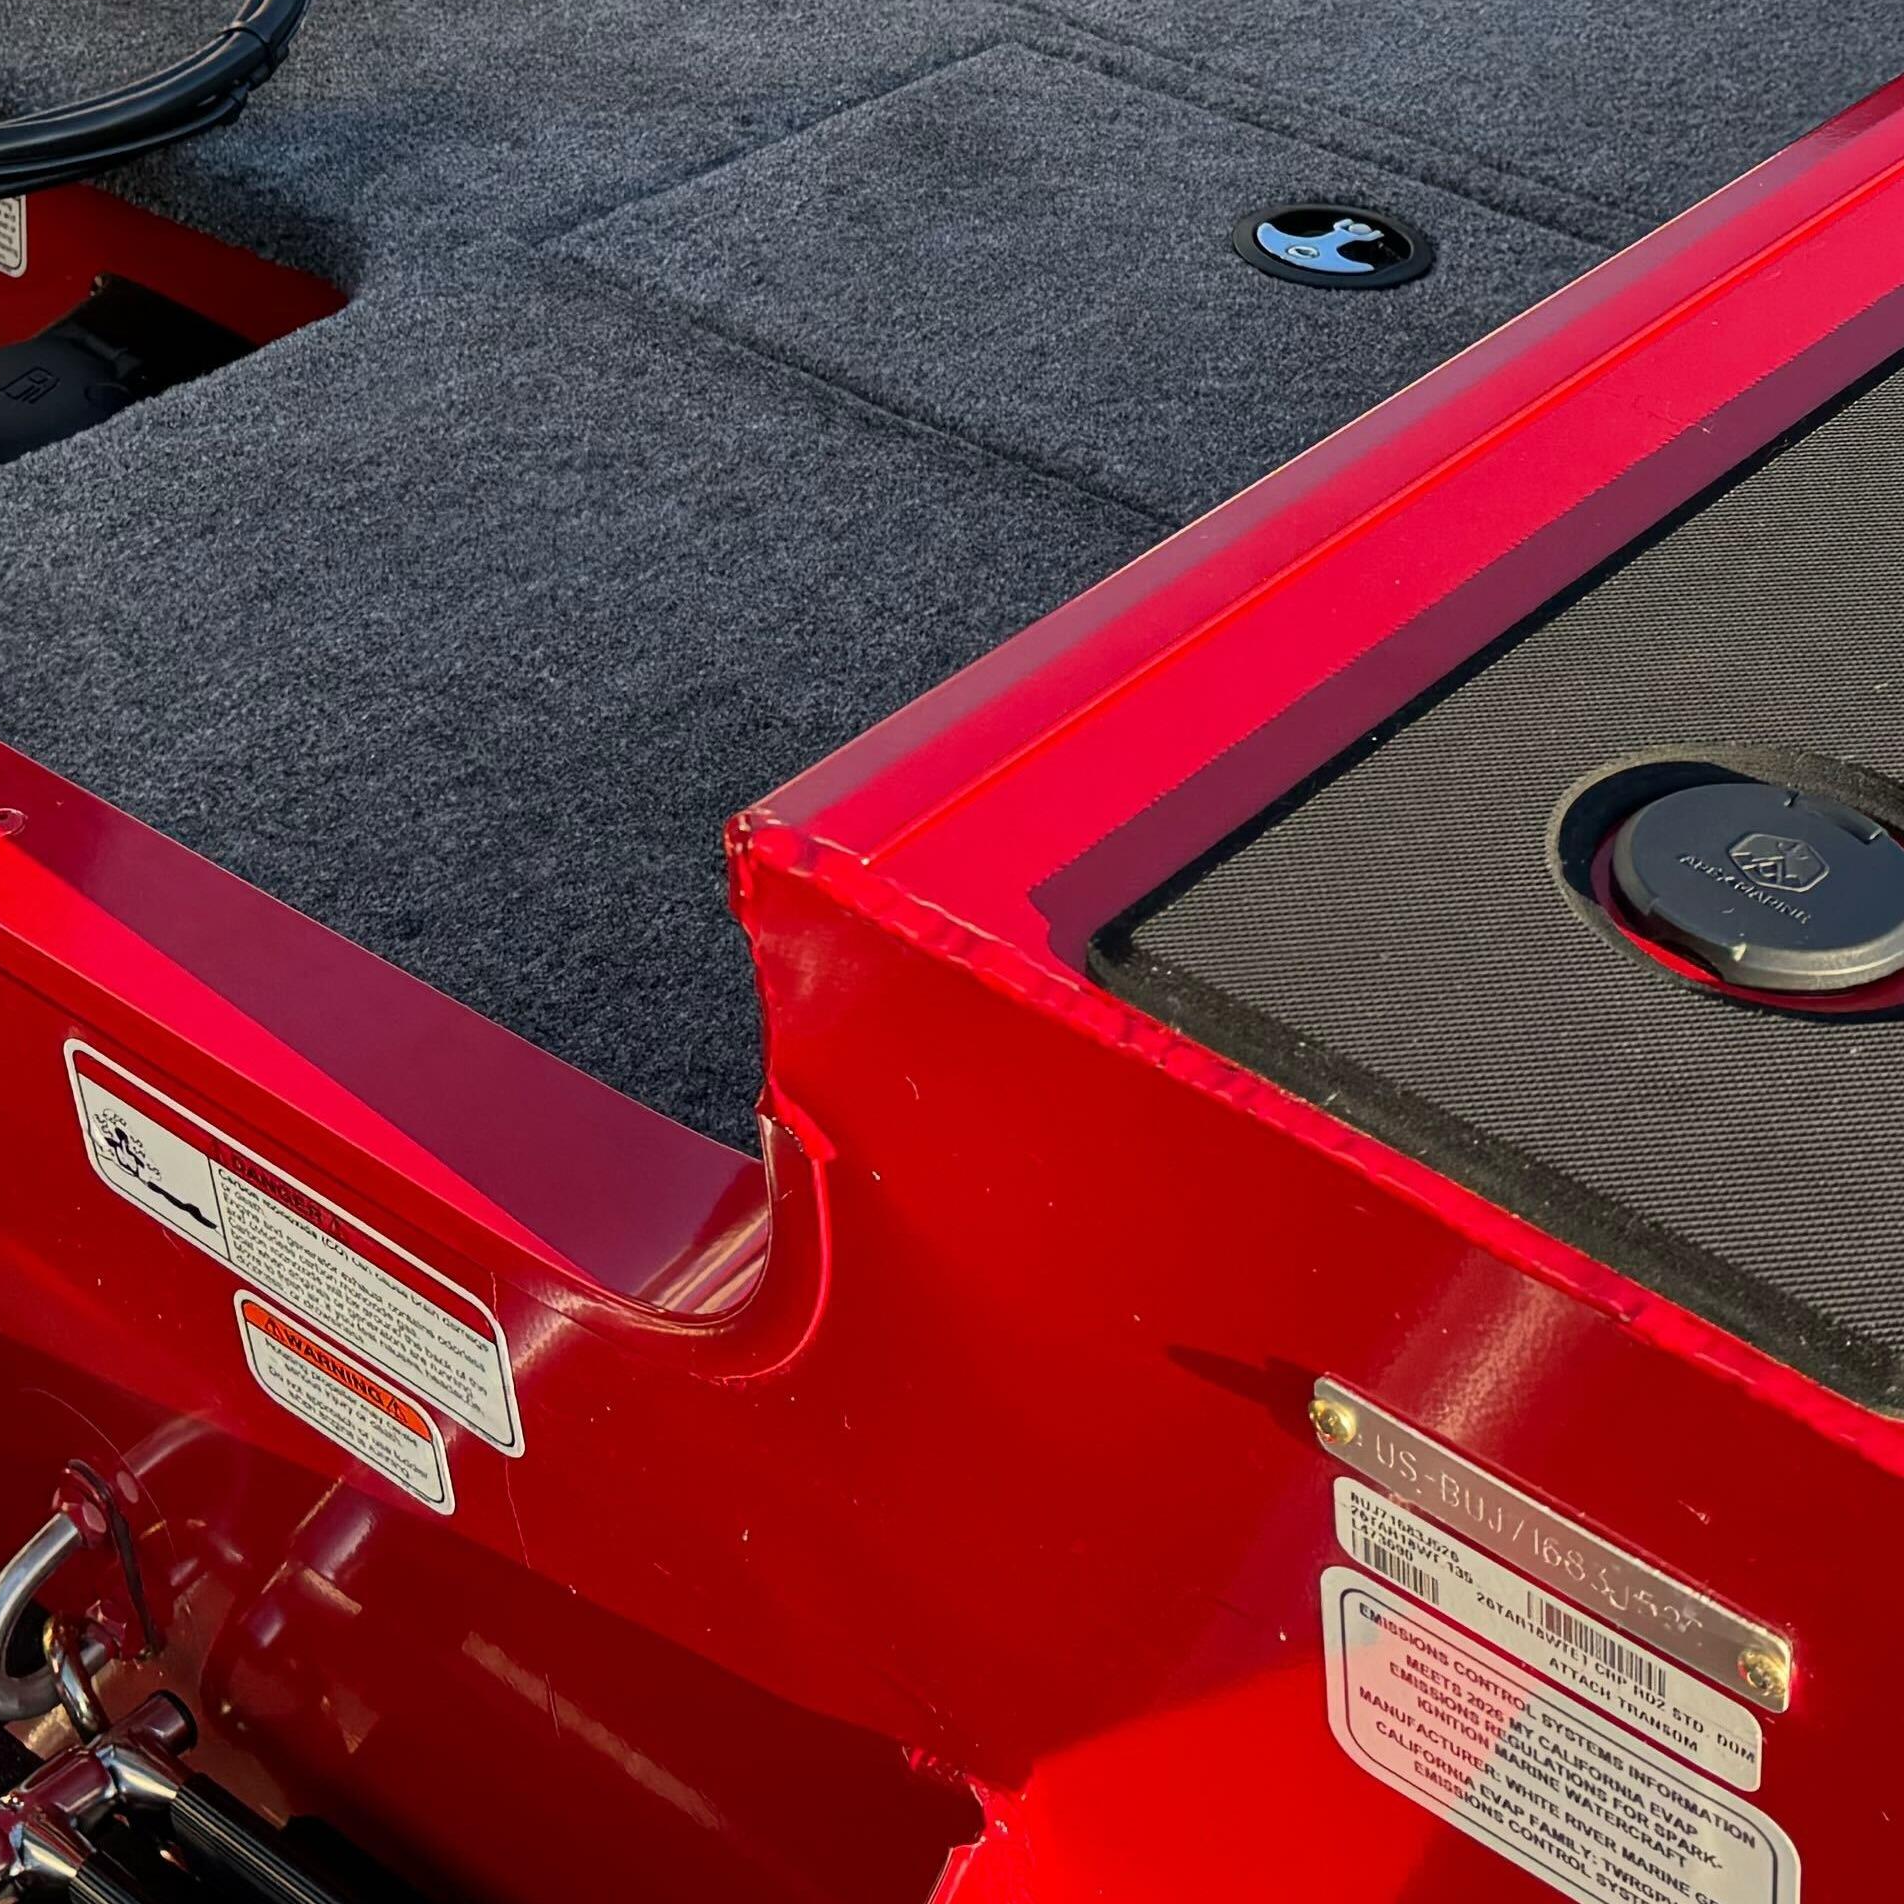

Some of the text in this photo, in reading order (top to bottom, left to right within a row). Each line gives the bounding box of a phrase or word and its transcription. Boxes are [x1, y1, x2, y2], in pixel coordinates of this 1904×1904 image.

[1678, 853, 1812, 926] APEX MARINE
[230, 1152, 323, 1225] DANGER
[320, 1233, 349, 1262] (CO)
[284, 1329, 384, 1406] WARNING
[1359, 1601, 1755, 1849] EMISSIONS CONTROL SYSTEMS INFORMATION
[1405, 1652, 1697, 1841] MEETS 2026 MY CALIFORNIA EVAP
[1548, 1654, 1697, 1753] ATTACH TRANSOM
[1716, 1731, 1755, 1765] DOM
[1359, 1684, 1689, 1898] MANUFACTURER: WHITE RIVER MARINE
[1375, 1718, 1475, 1791] CALIFORNIA
[1479, 1782, 1524, 1821] EVAP
[1529, 1812, 1597, 1866] FAMILY:
[1389, 1660, 1723, 1874] EMISSIONS REGULATIONS FOR SPARK-
[1413, 1758, 1503, 1825] EMISSIONS
[1507, 1816, 1591, 1880] CONTROL
[1416, 1695, 1687, 1870] IGNITION MARINE WATERCRAFT
